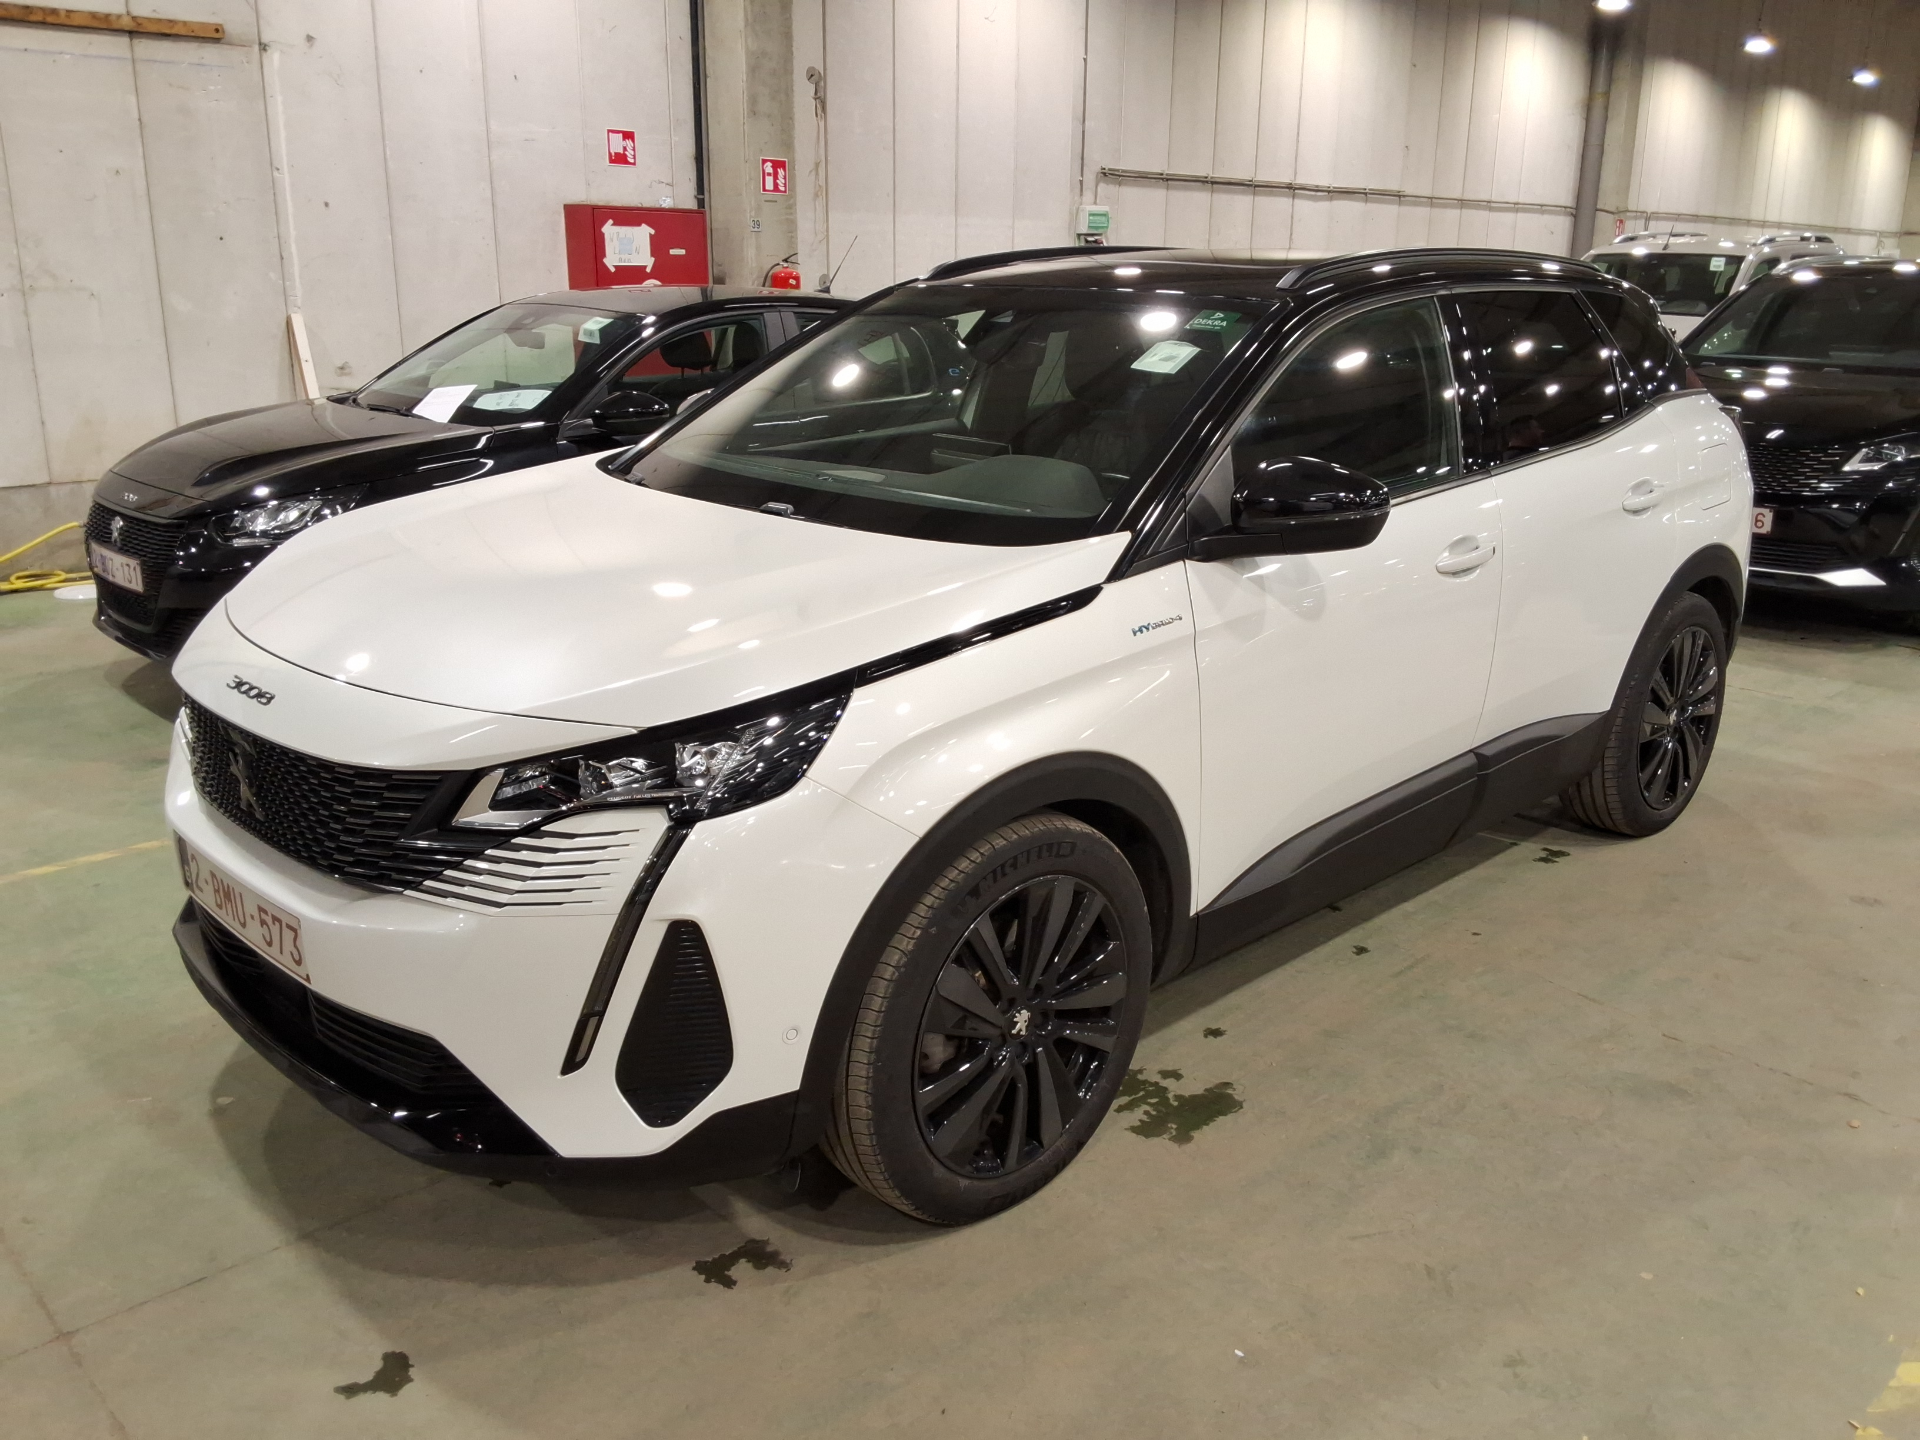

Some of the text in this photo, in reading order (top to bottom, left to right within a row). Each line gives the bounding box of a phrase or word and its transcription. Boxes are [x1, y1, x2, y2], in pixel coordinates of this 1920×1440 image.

[751, 219, 761, 230] 39
[1193, 318, 1227, 327] DEKRA
[1754, 512, 1766, 529] 6
[226, 674, 276, 706] 3008
[190, 853, 303, 967] 2-BMU-573
